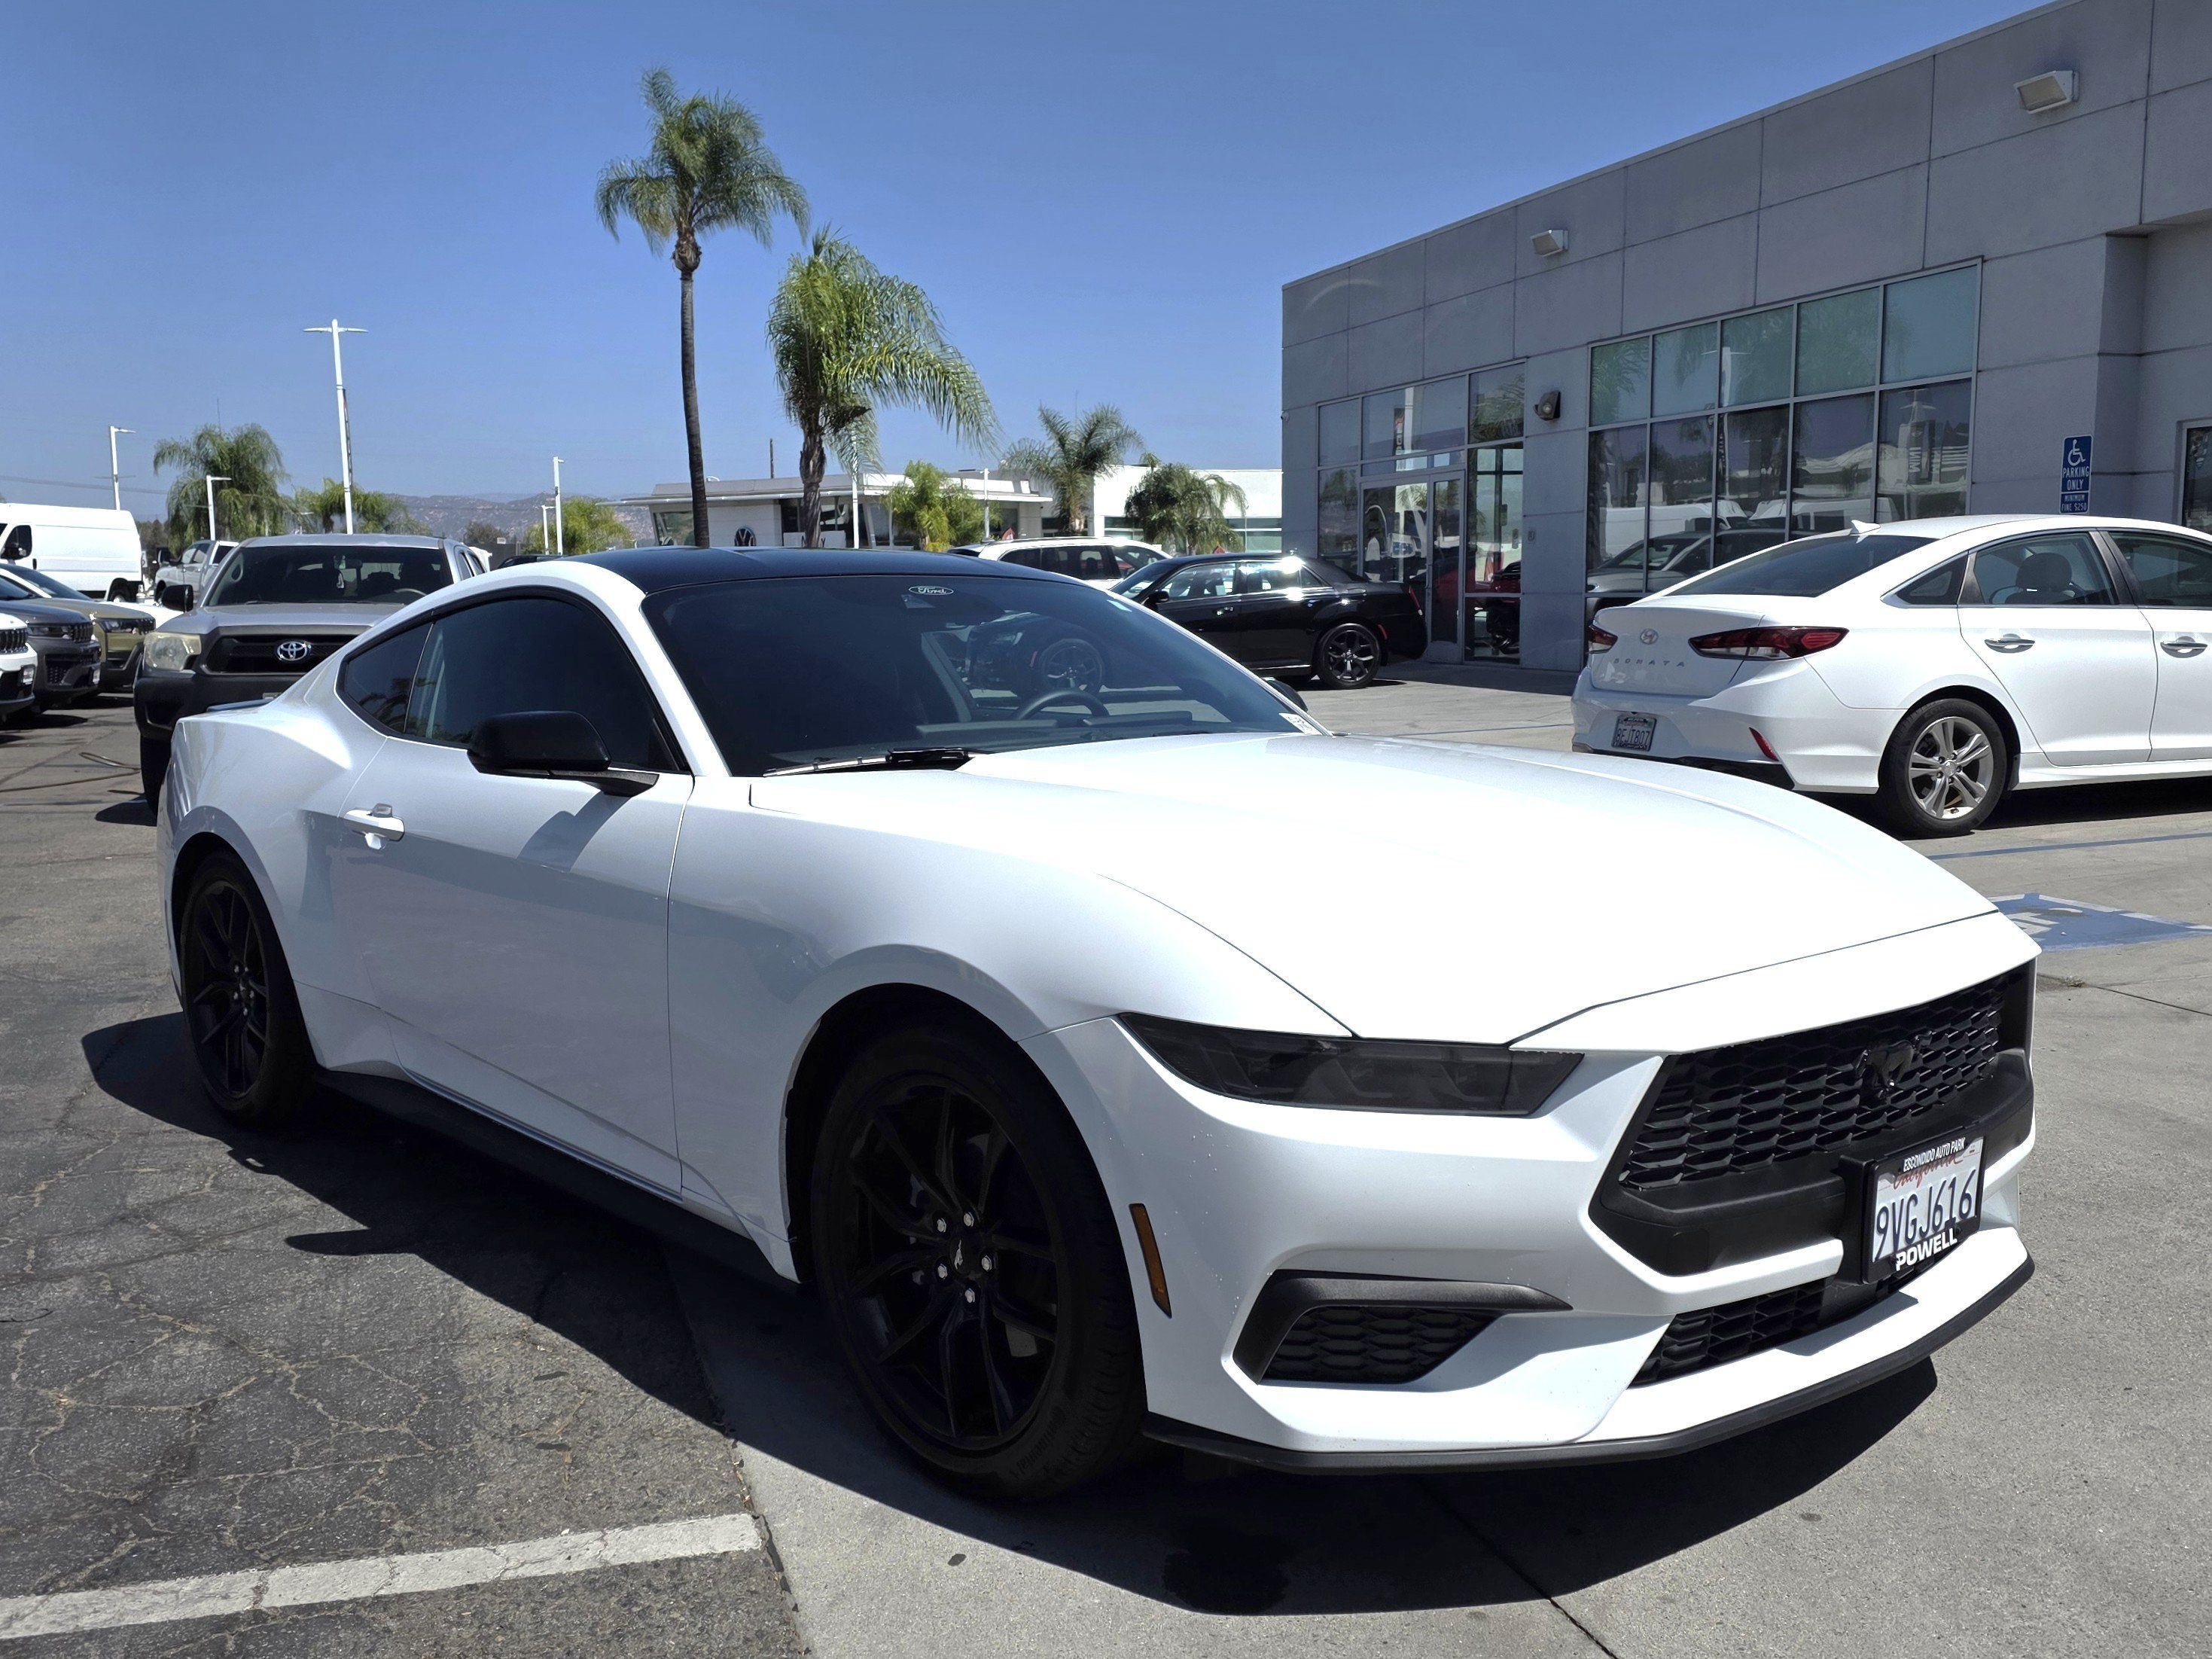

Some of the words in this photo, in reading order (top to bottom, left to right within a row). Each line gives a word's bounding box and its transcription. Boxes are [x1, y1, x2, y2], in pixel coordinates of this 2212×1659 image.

[2063, 466, 2090, 478] PARKING
[2067, 479, 2084, 491] ONLY
[2064, 494, 2086, 502] MINIMUM
[2061, 503, 2072, 511] FINE
[2074, 502, 2087, 511] $250
[1613, 657, 1685, 667] SONATA
[1903, 1148, 1936, 1173] ESCONDIDO
[1935, 1142, 1951, 1160] AUTO
[1951, 1137, 1966, 1154] PARK
[1875, 1169, 1976, 1260] 9VGJ616
[1896, 1227, 1958, 1271] POWELL
